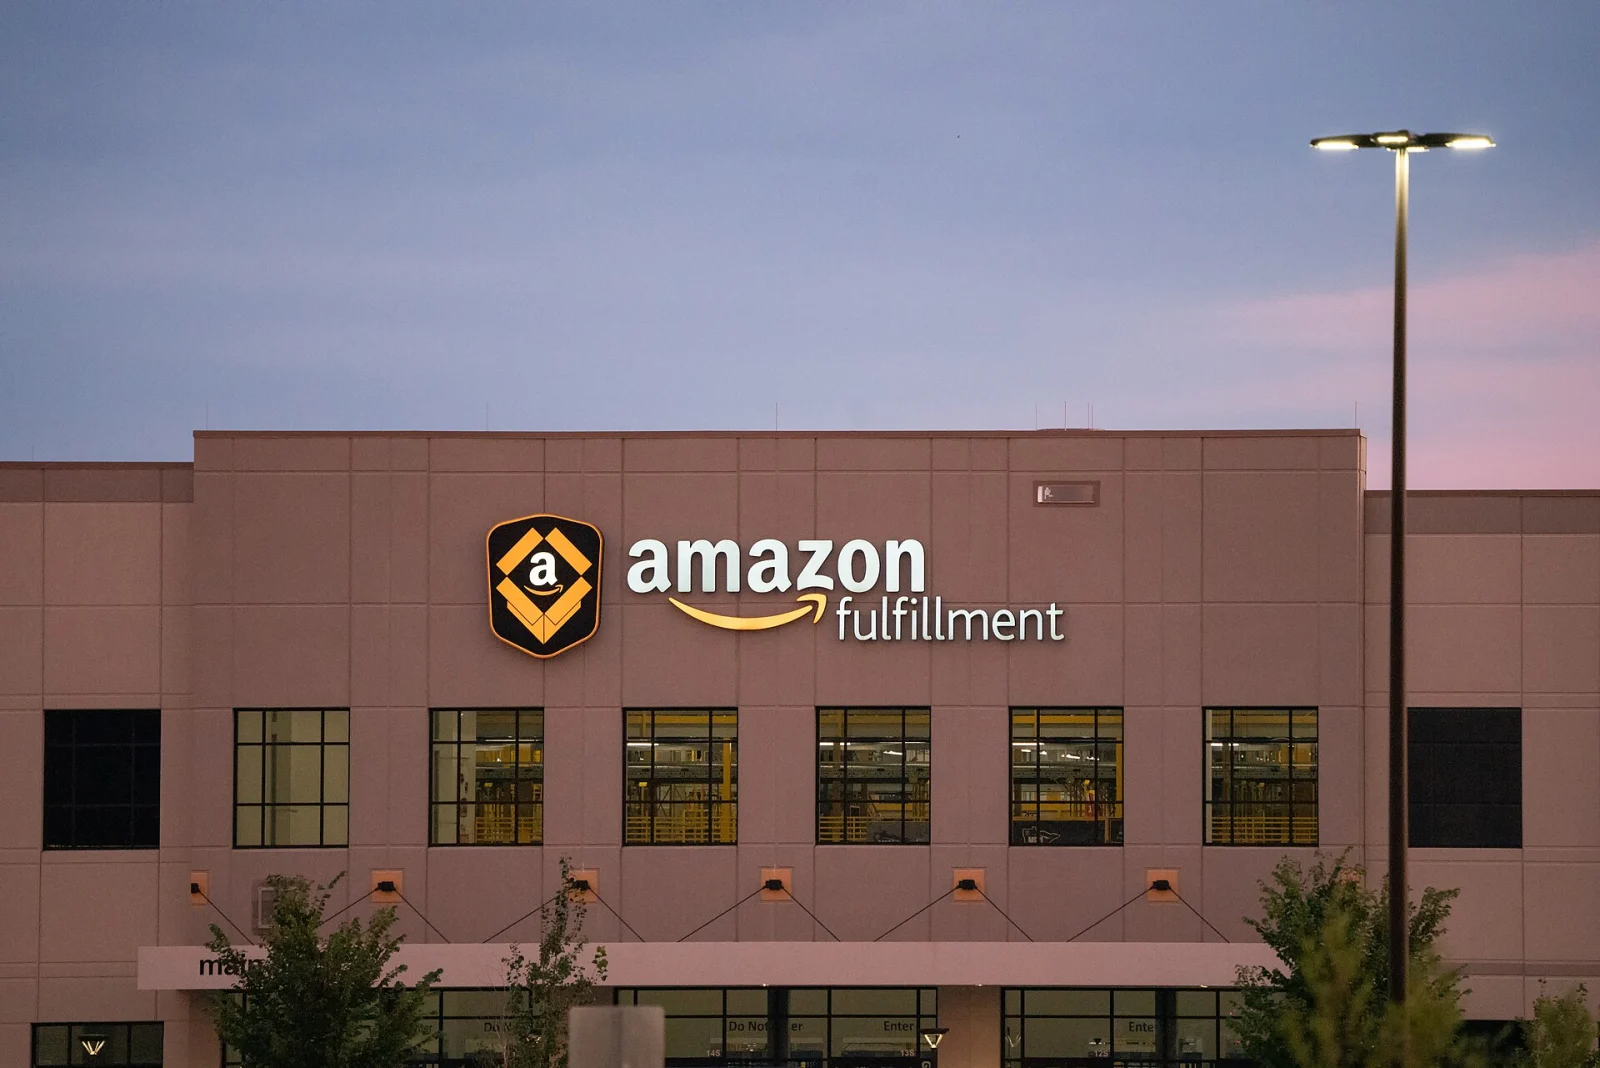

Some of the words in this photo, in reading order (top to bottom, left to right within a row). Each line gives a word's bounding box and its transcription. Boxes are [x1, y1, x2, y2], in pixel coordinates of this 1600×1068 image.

[529, 551, 558, 586] a
[627, 538, 926, 594] amazon
[836, 596, 1065, 641] fulfillment
[729, 1021, 745, 1031] Do
[884, 1021, 914, 1031] Enter
[1129, 1021, 1154, 1032] Ente
